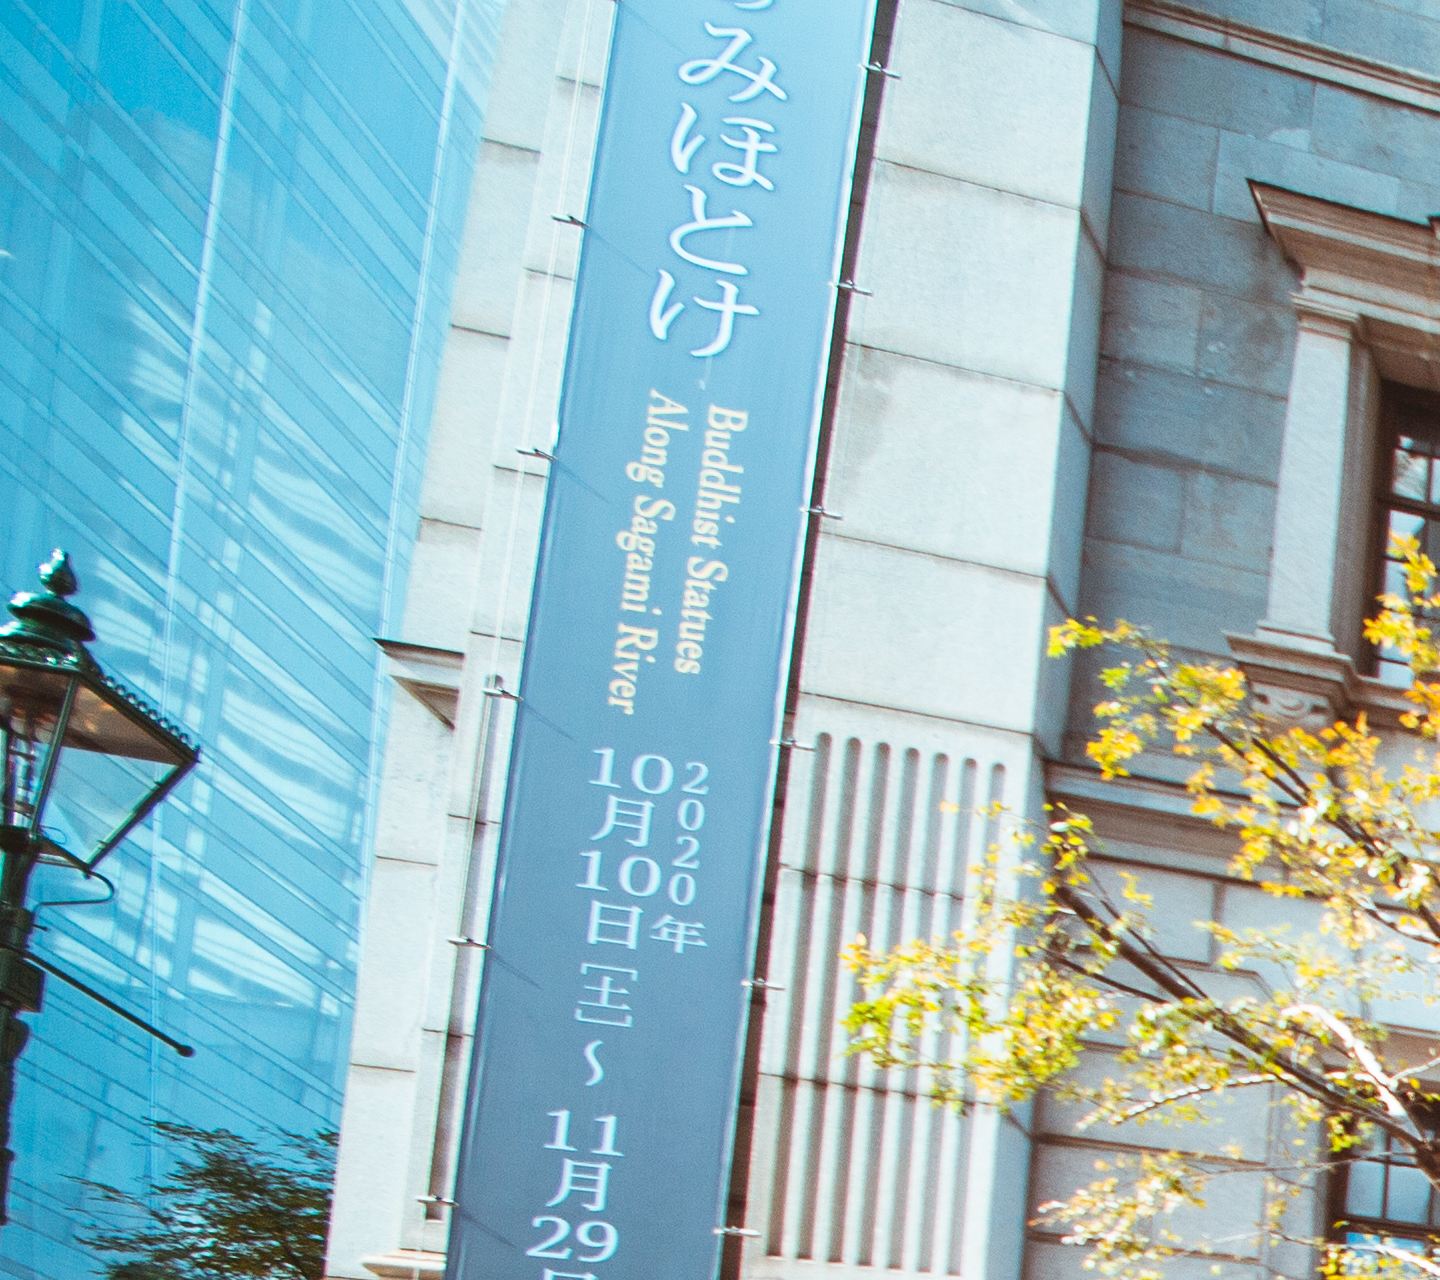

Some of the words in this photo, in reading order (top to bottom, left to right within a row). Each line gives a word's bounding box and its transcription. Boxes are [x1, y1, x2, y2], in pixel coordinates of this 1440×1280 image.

[649, 0, 788, 358] みほとけ
[624, 388, 690, 489] Along
[689, 403, 749, 549] Buddhist
[614, 495, 677, 616] Sagami
[673, 556, 729, 675] Statues
[607, 622, 660, 716] River
[649, 760, 708, 954] 2020年
